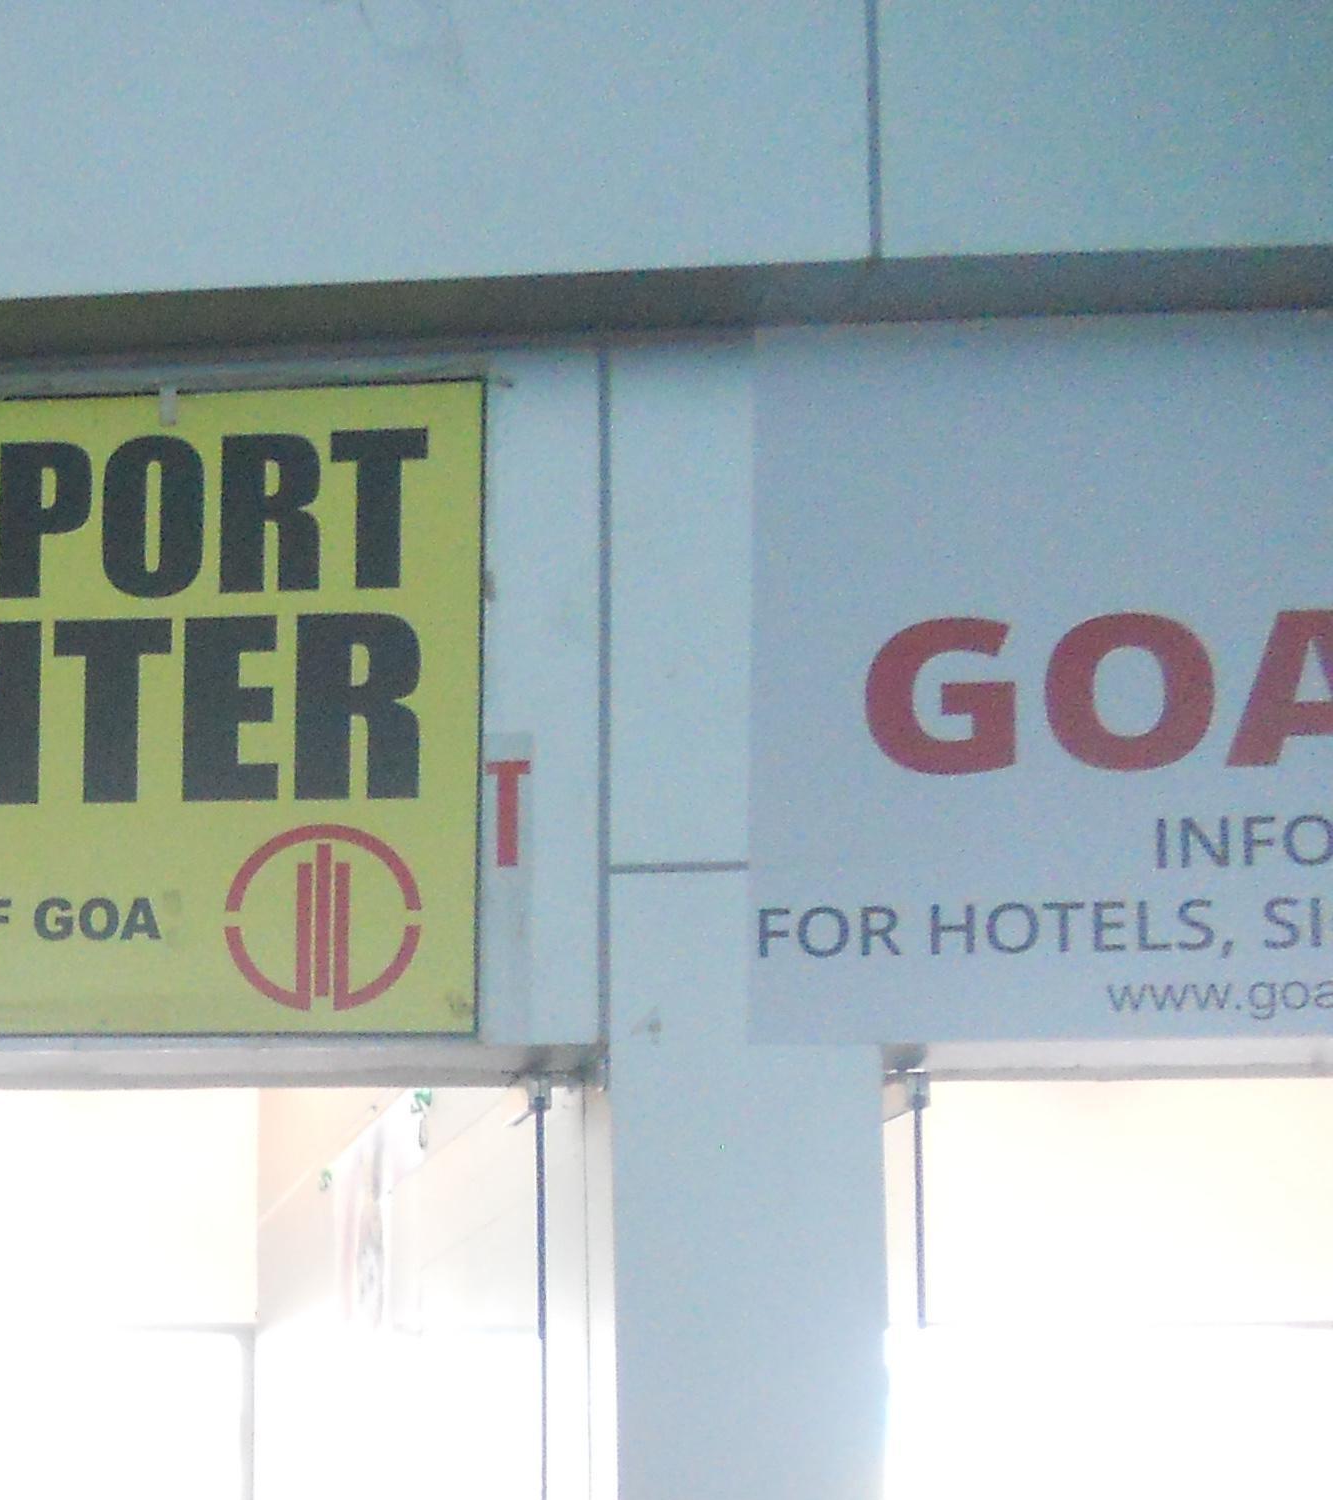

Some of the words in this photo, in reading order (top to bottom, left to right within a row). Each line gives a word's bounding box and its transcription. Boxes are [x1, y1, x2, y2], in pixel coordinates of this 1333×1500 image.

[865, 608, 1333, 775] GOA
[33, 896, 161, 942] GOA
[757, 905, 901, 959] FOR
[930, 898, 1233, 959] HOTELS,
